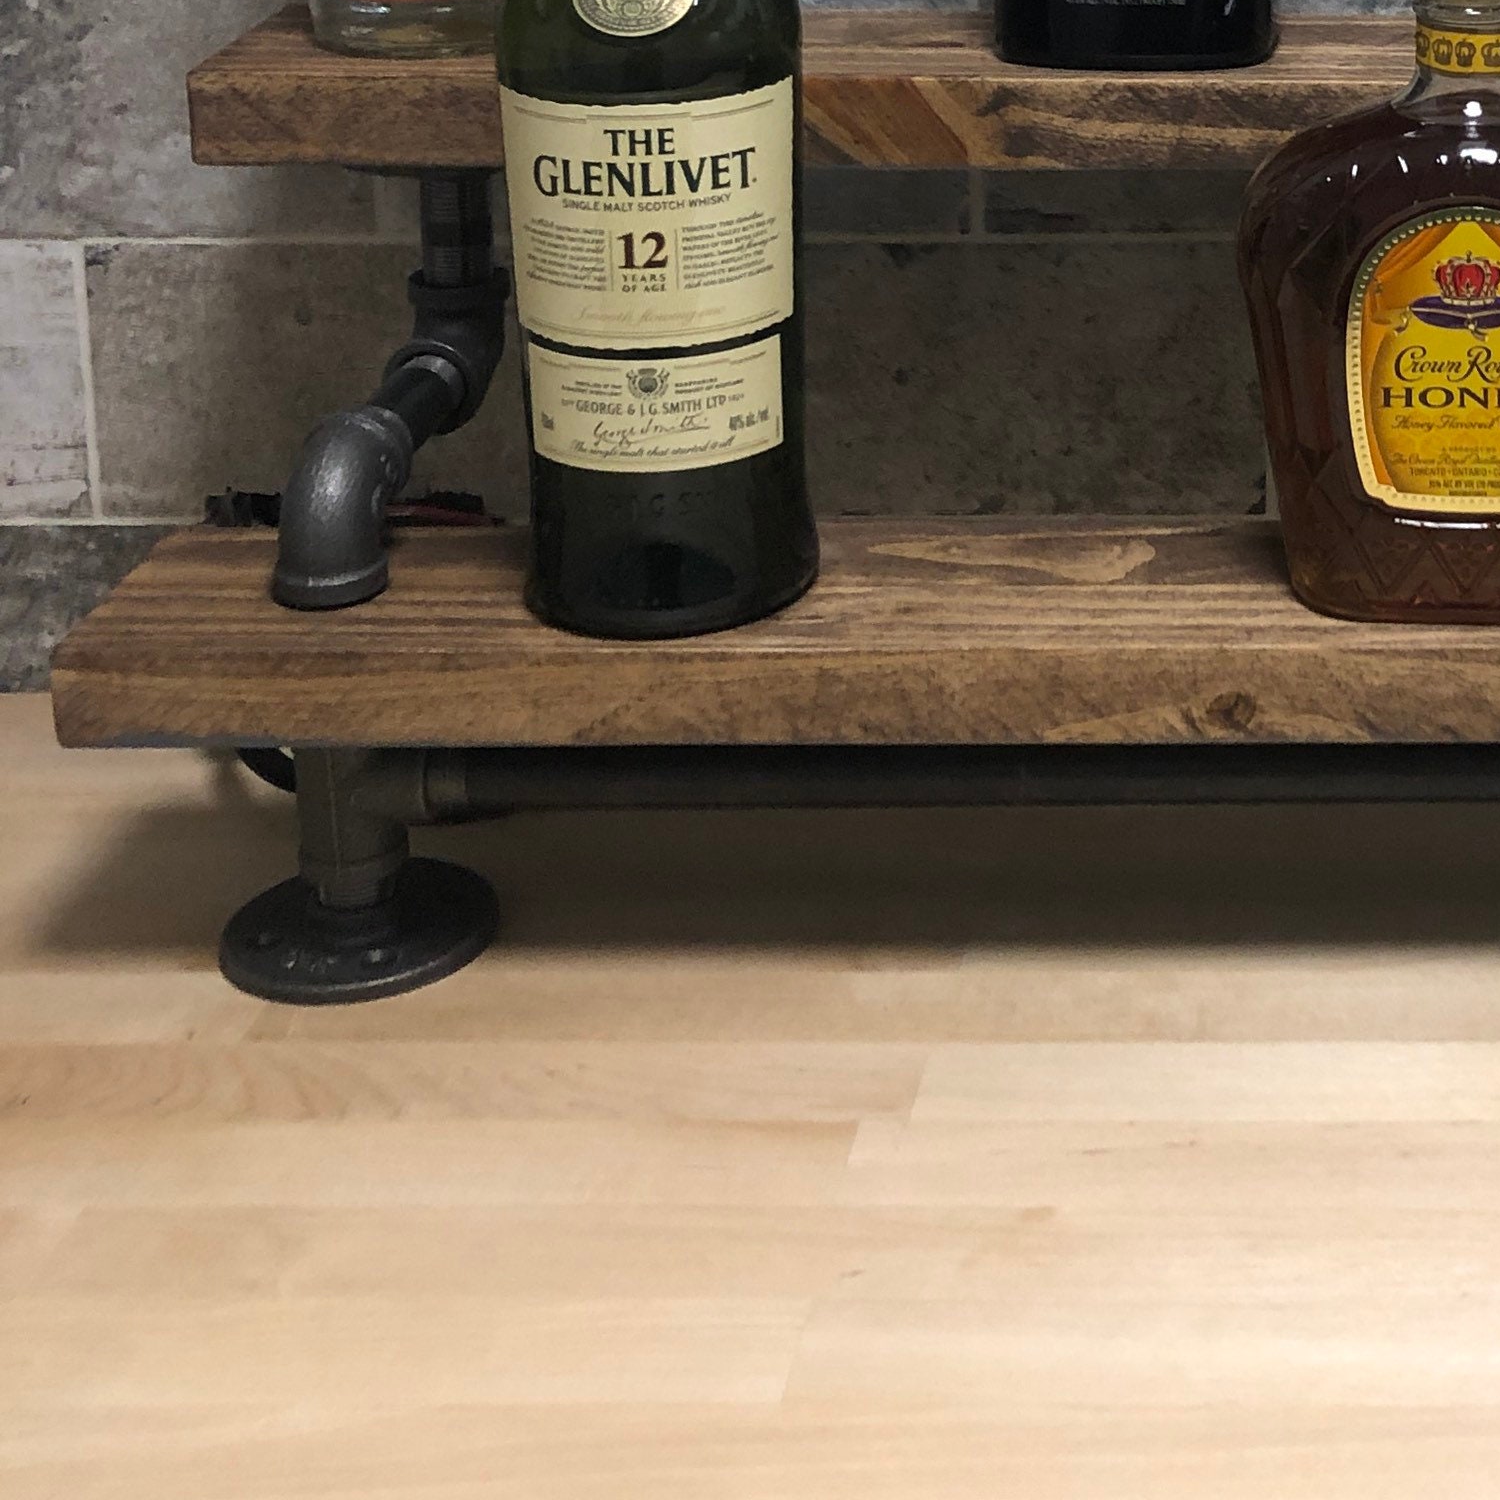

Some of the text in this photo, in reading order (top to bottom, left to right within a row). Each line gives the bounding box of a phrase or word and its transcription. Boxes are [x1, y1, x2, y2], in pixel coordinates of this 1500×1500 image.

[603, 128, 676, 156] THE
[562, 192, 732, 213] SINGLE MALT SCOTCH WHISKY
[616, 230, 669, 270] 12
[621, 274, 667, 284] YEARS
[622, 284, 667, 294] OF AGE
[1394, 345, 1462, 382] Crown
[576, 399, 623, 416] GEORGE
[627, 402, 636, 416] &
[662, 398, 702, 414] SMITH
[706, 394, 727, 410] LTD
[1452, 467, 1488, 476] ONTARIO
